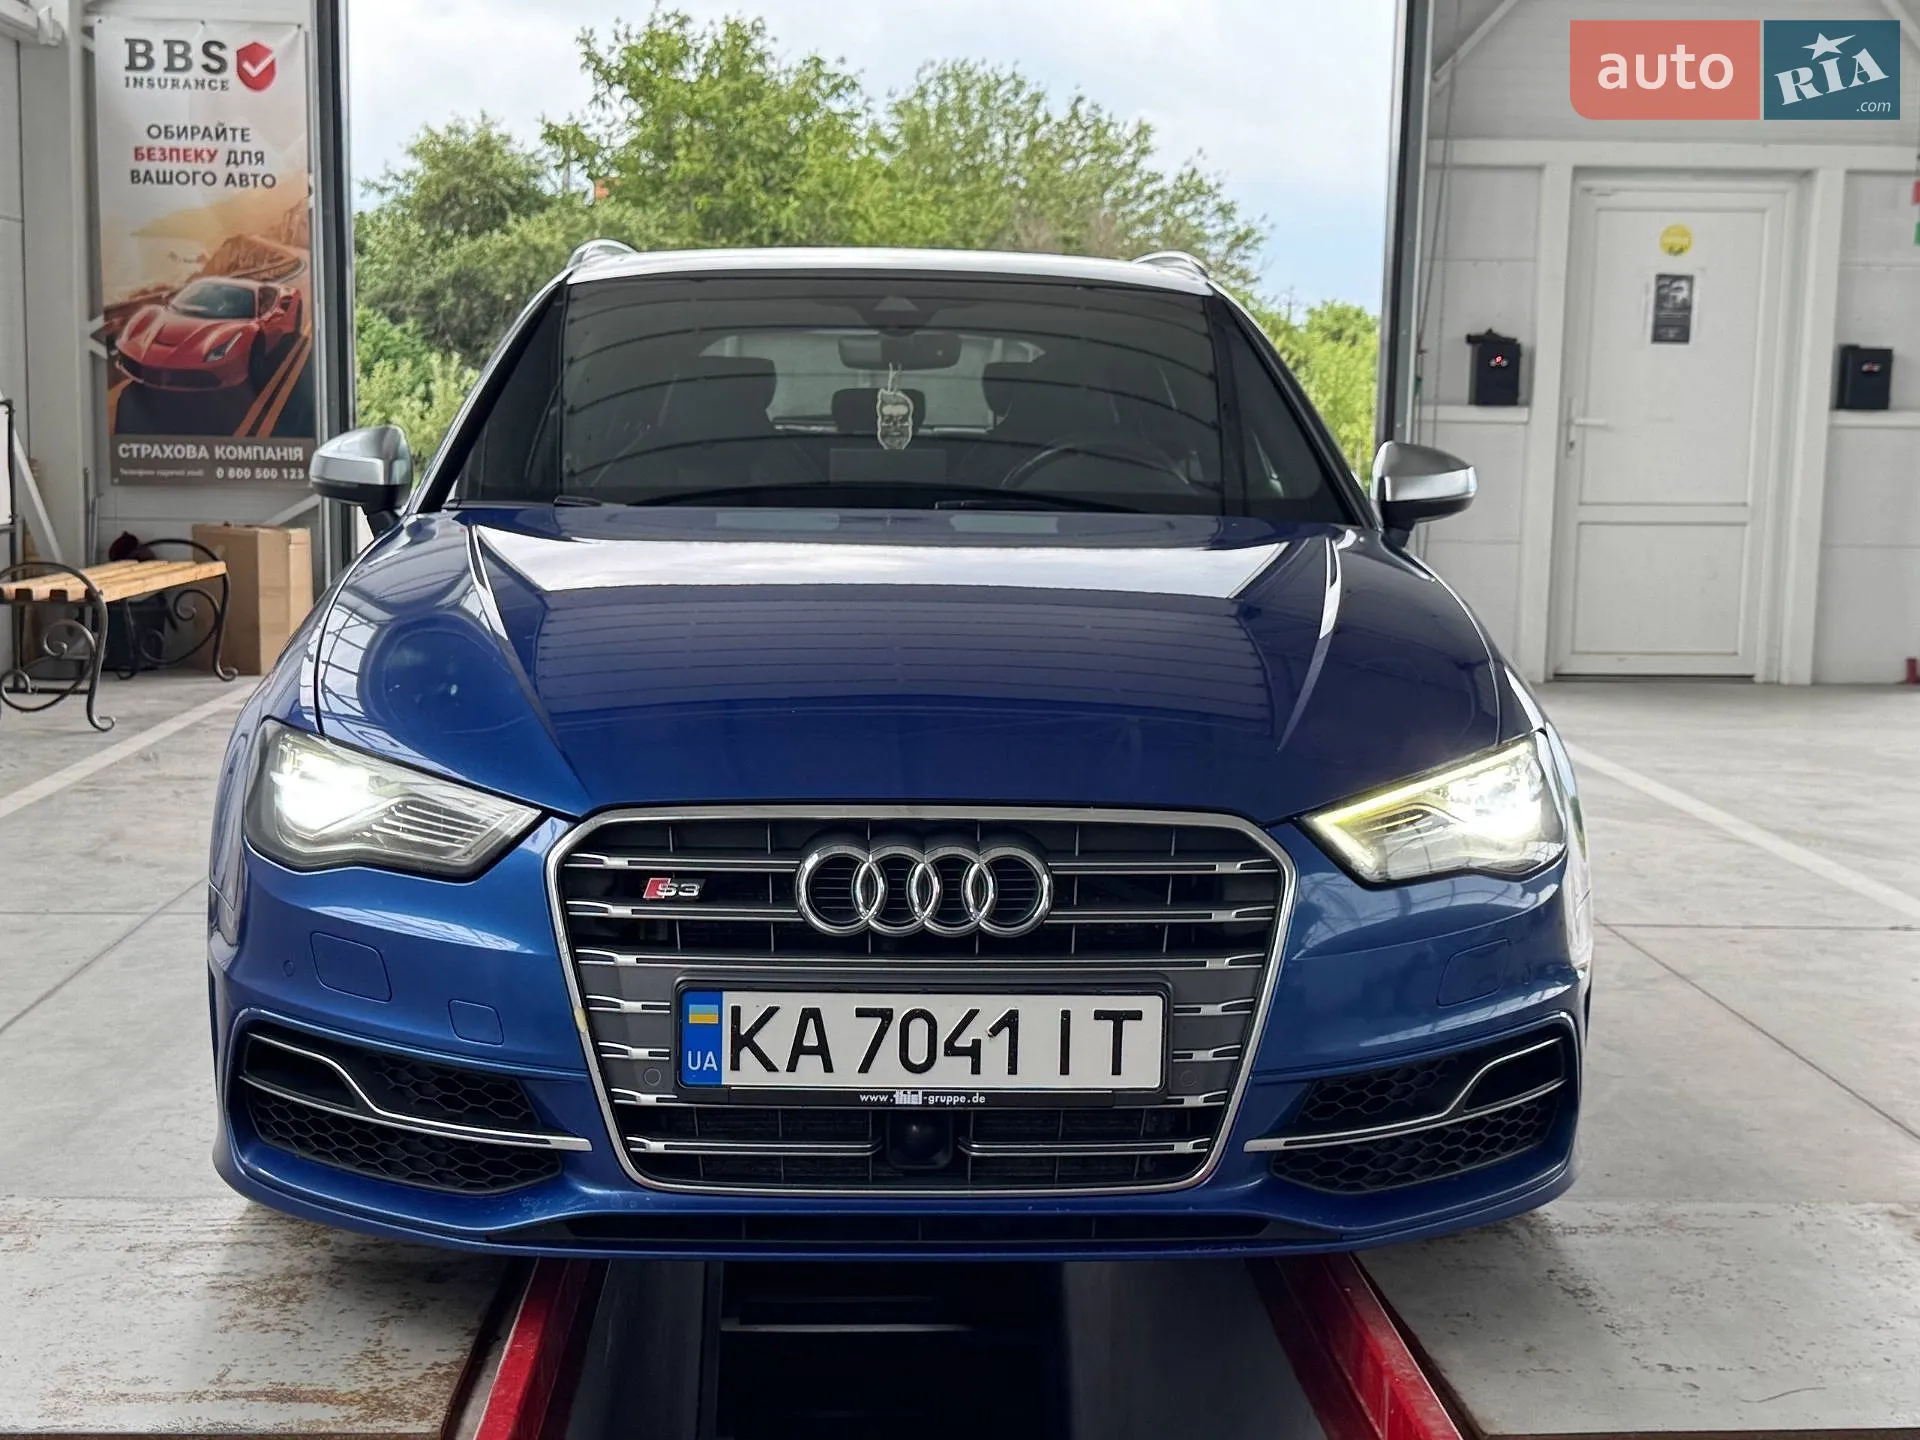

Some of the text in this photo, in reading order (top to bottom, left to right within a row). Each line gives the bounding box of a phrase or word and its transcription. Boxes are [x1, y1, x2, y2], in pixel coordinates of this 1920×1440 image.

[124, 38, 228, 75] BBS
[124, 76, 231, 91] INSURANCE
[146, 121, 251, 143] ОБИРАЙТЕ
[133, 146, 265, 166] БЕЗПЕКУ ДЛЯ
[130, 169, 276, 189] ВАШОГО АВТО
[118, 443, 304, 462] СТРАХОВА КОМПАНІЯ
[215, 466, 224, 480] 0
[254, 467, 278, 480] 500
[656, 882, 701, 897] S3
[729, 1004, 1144, 1077] KA 7041 IT
[687, 1050, 718, 1072] UA
